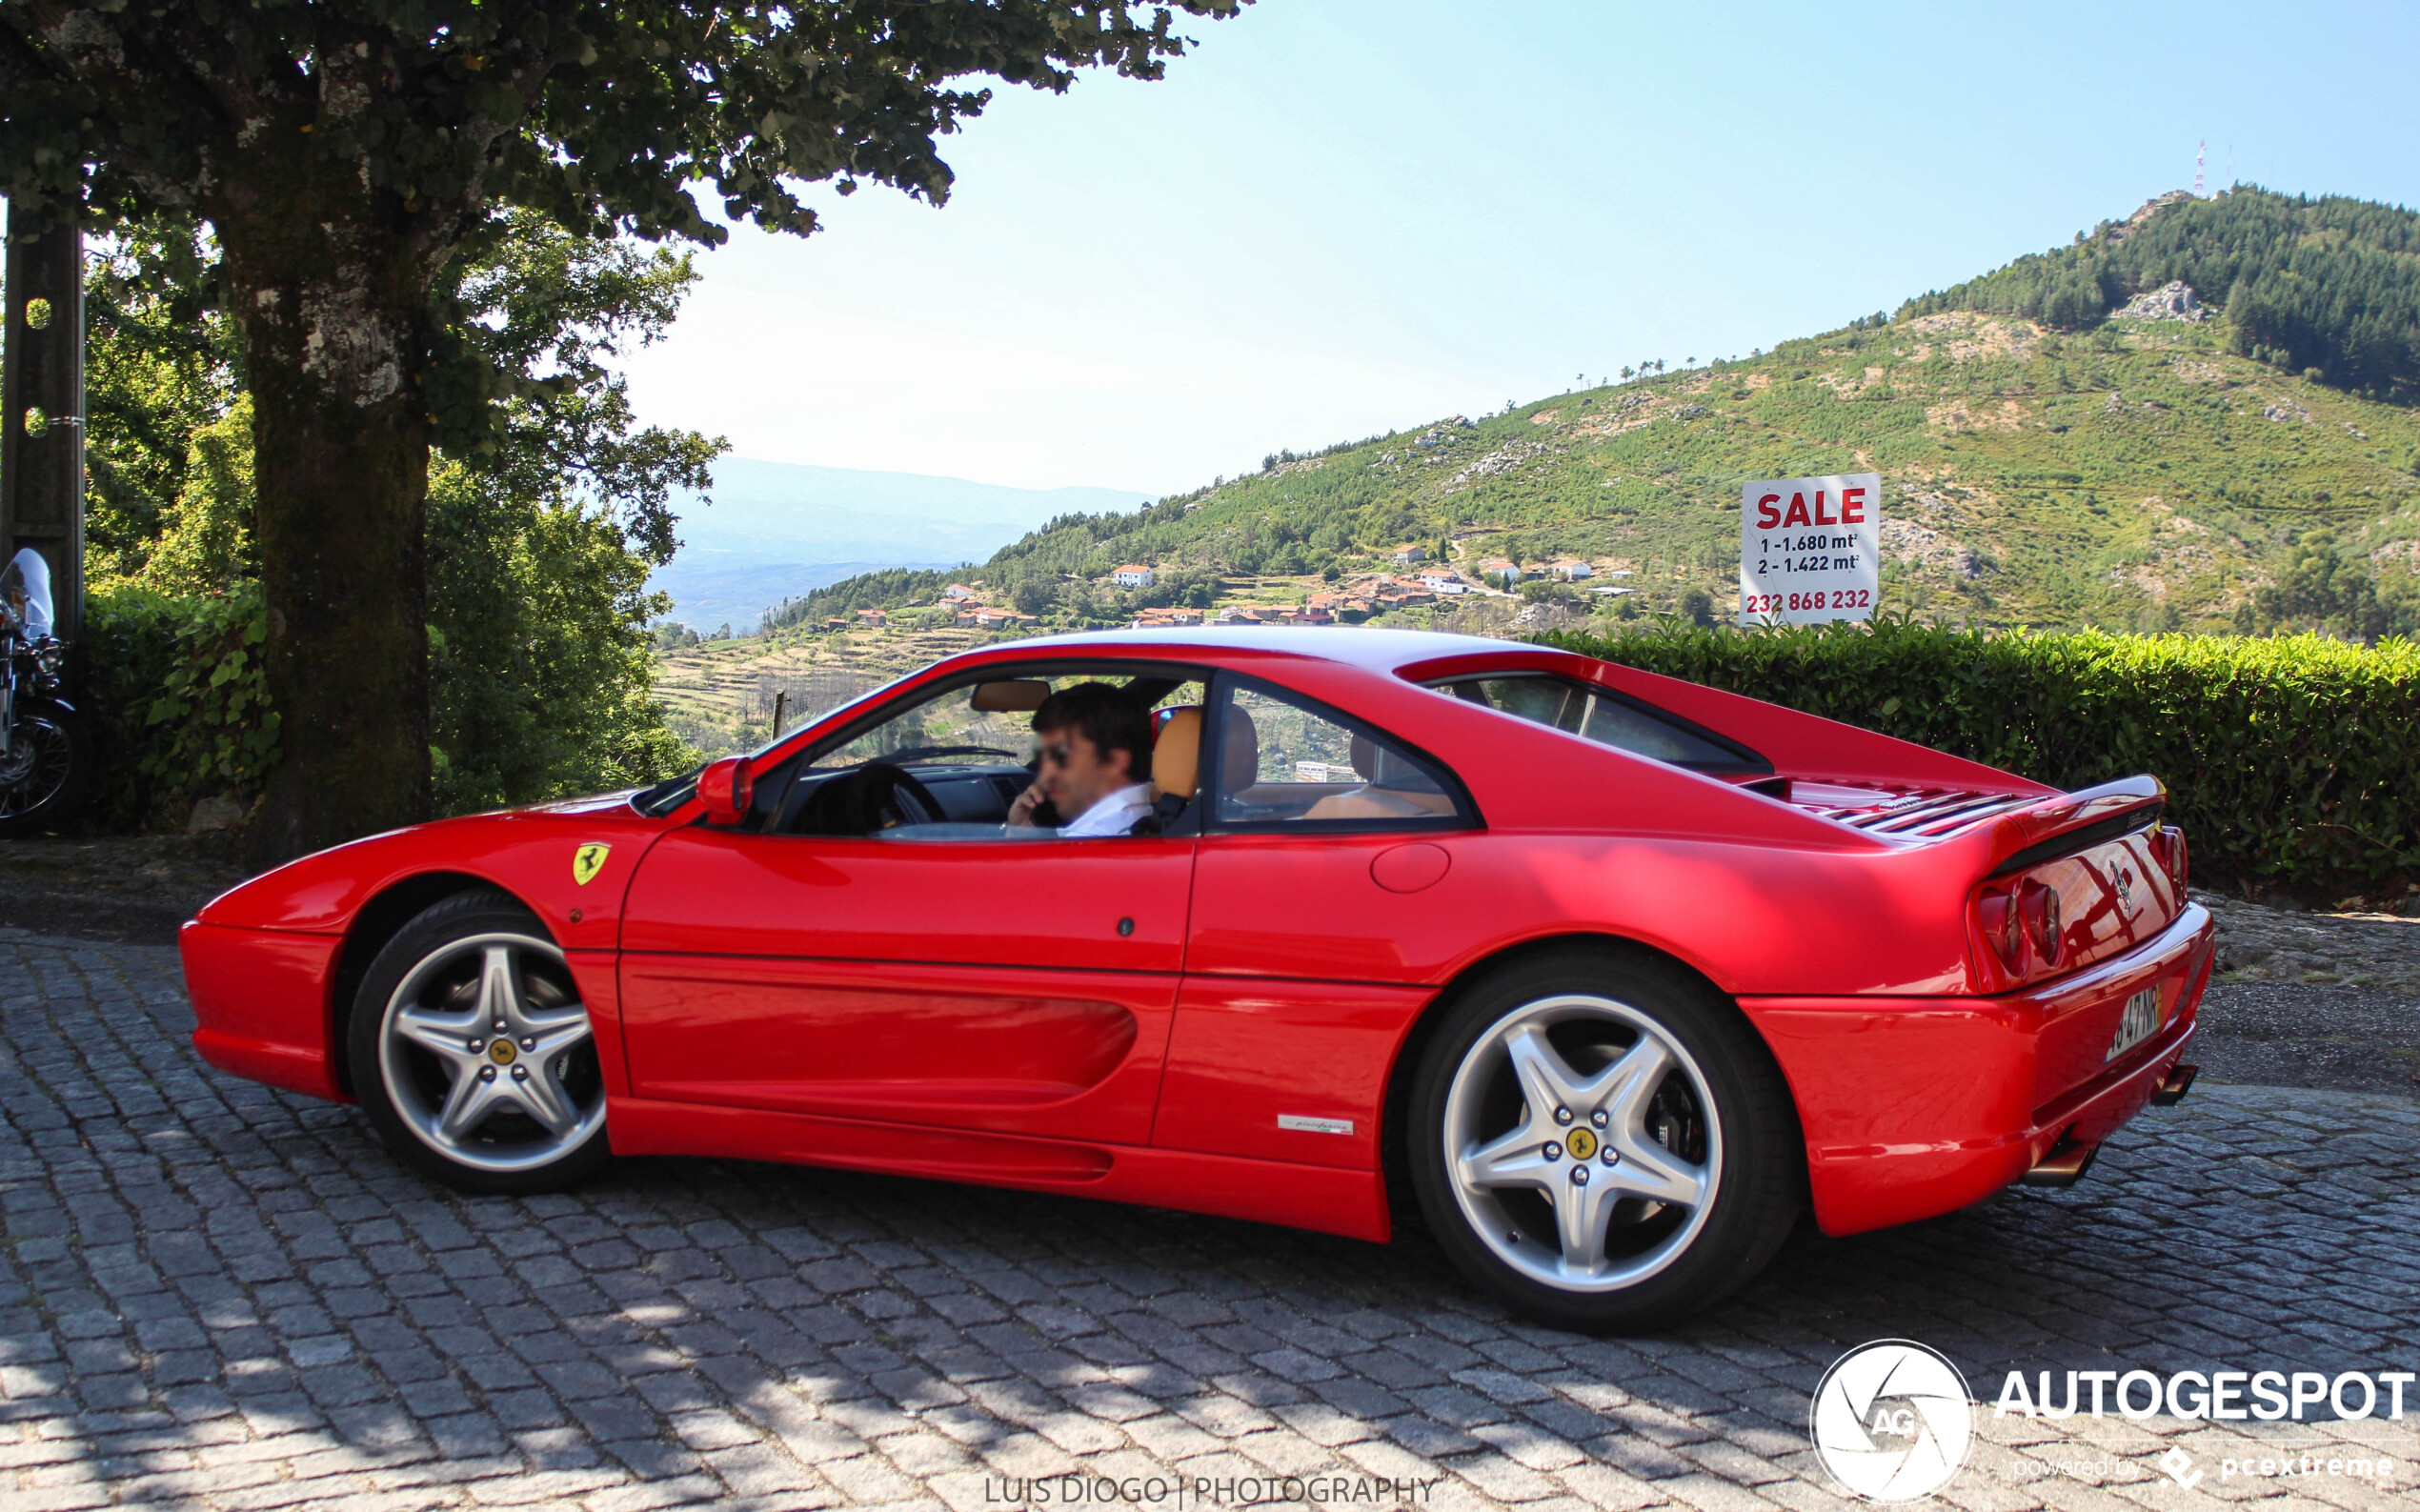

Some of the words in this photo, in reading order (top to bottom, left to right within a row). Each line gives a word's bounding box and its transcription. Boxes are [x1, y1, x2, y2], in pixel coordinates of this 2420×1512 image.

[1756, 488, 1865, 530] SALE
[1761, 537, 1768, 554] 1
[1758, 559, 1767, 575] 2
[1784, 555, 1829, 573] 1.422
[1746, 594, 1784, 614] 232
[1788, 591, 1825, 611] 868
[1831, 589, 1869, 609] 232
